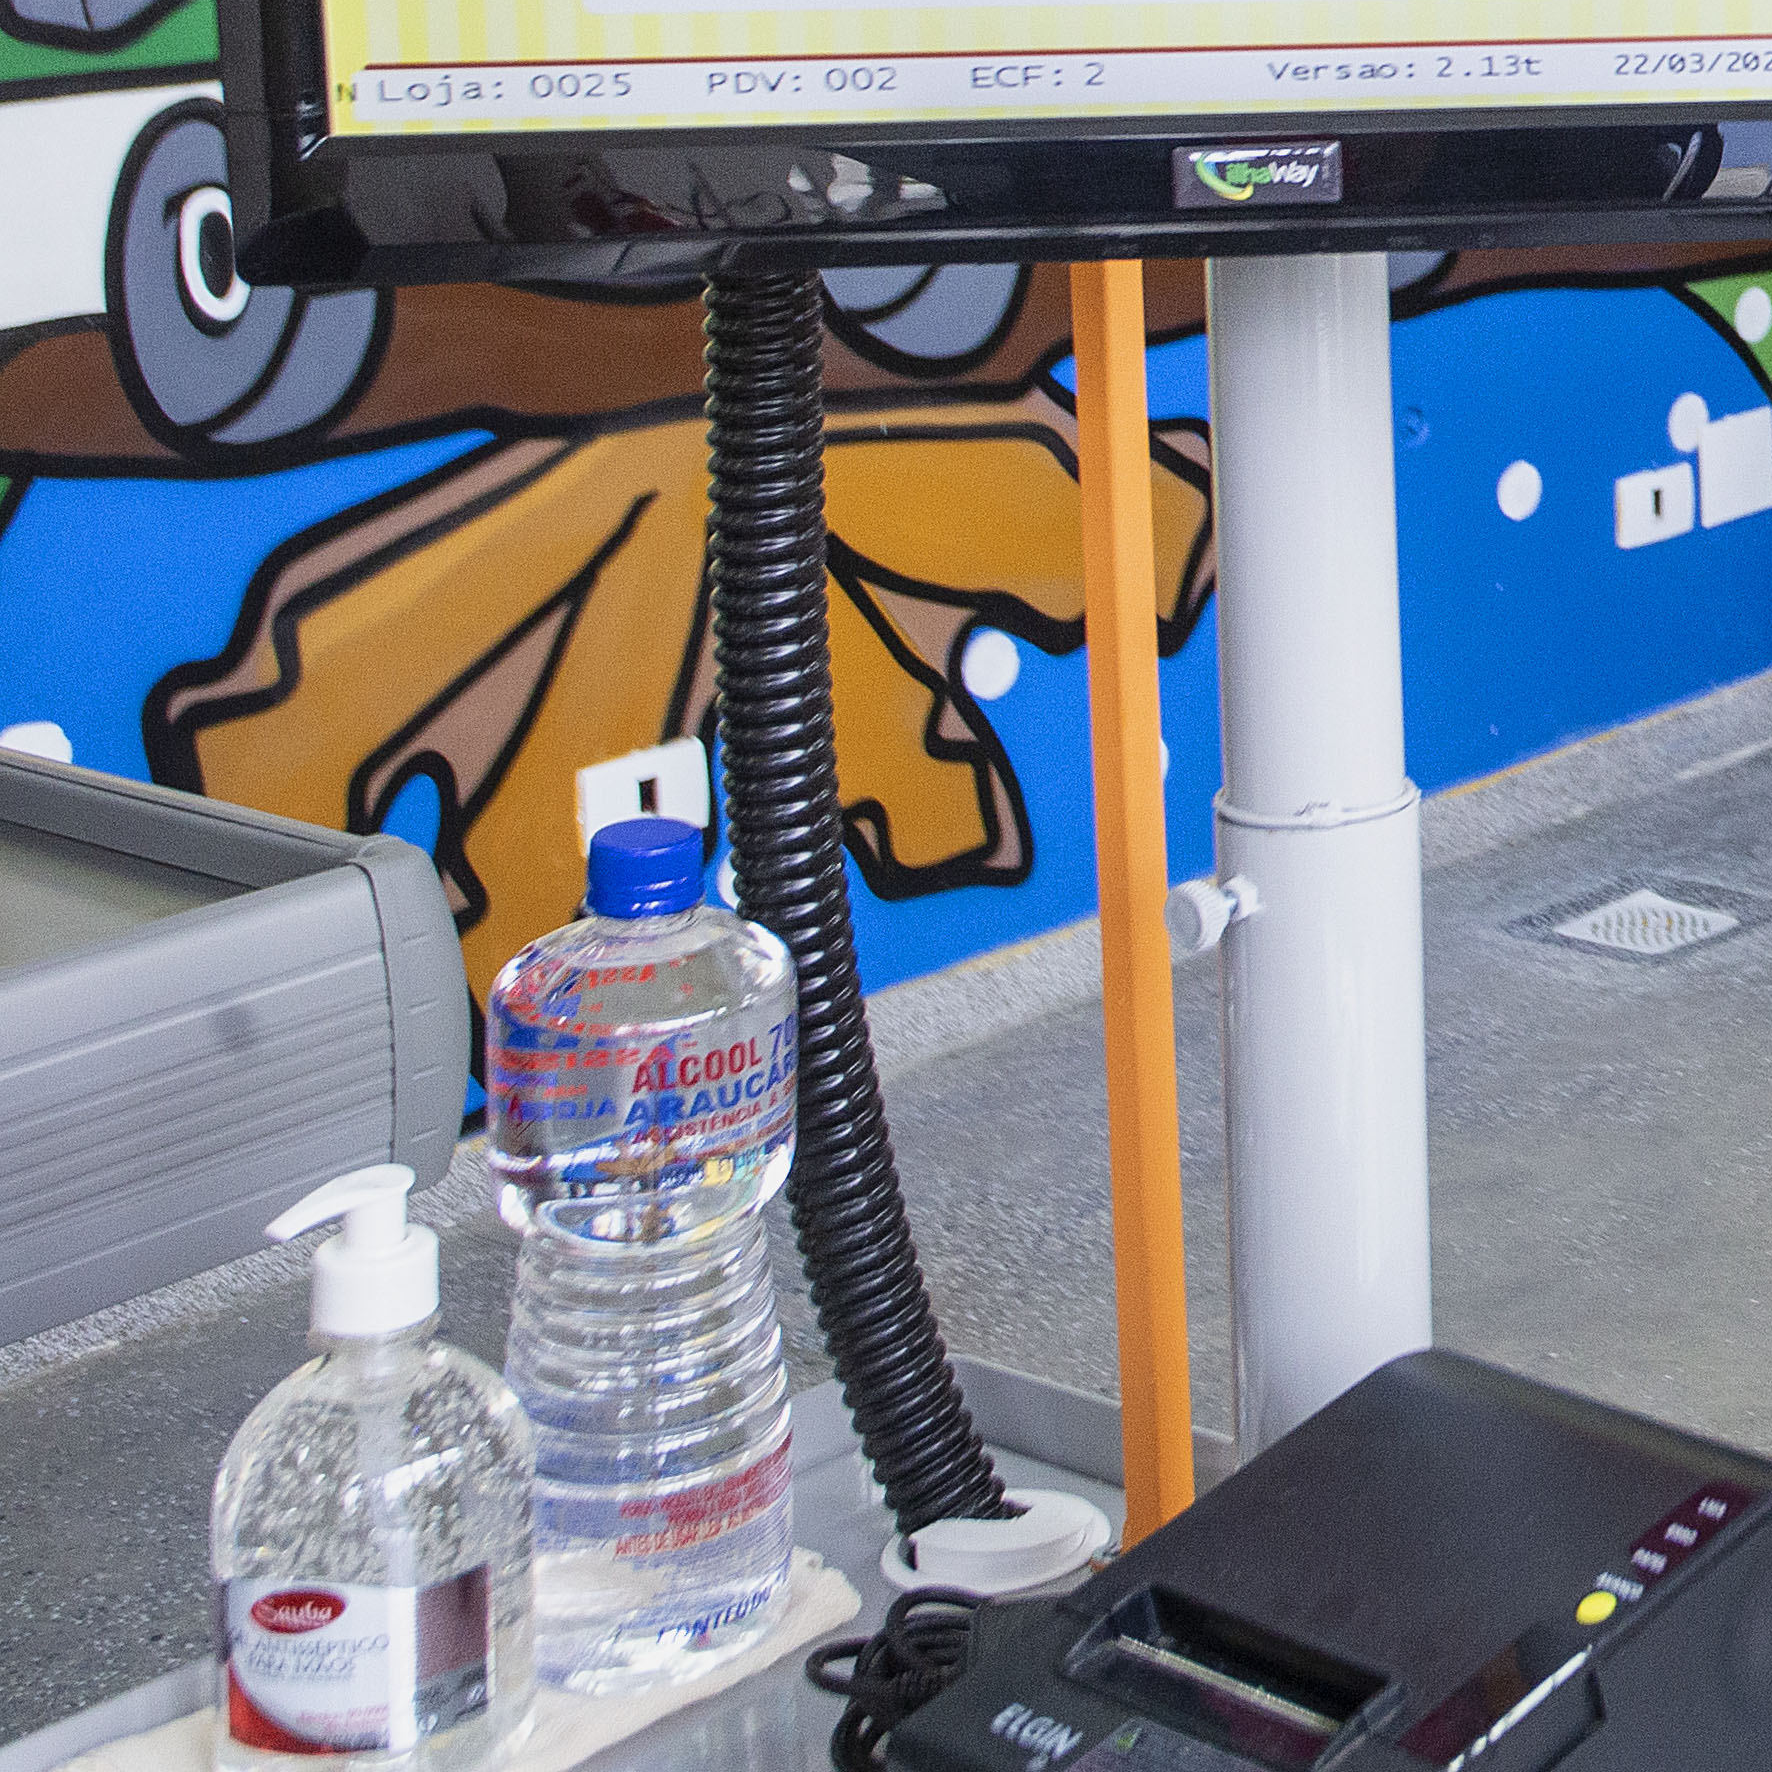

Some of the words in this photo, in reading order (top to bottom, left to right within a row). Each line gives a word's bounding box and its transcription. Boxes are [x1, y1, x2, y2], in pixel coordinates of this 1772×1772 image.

[377, 74, 505, 106] Loja:
[529, 71, 633, 99] 0025
[707, 68, 806, 95] PDV:
[824, 65, 899, 92] 002
[970, 62, 1066, 89] ECF:
[1082, 61, 1107, 87] 2
[1266, 57, 1418, 82] Versao:
[1435, 53, 1542, 79] 2.13t
[988, 1701, 1085, 1761] ELGIN
